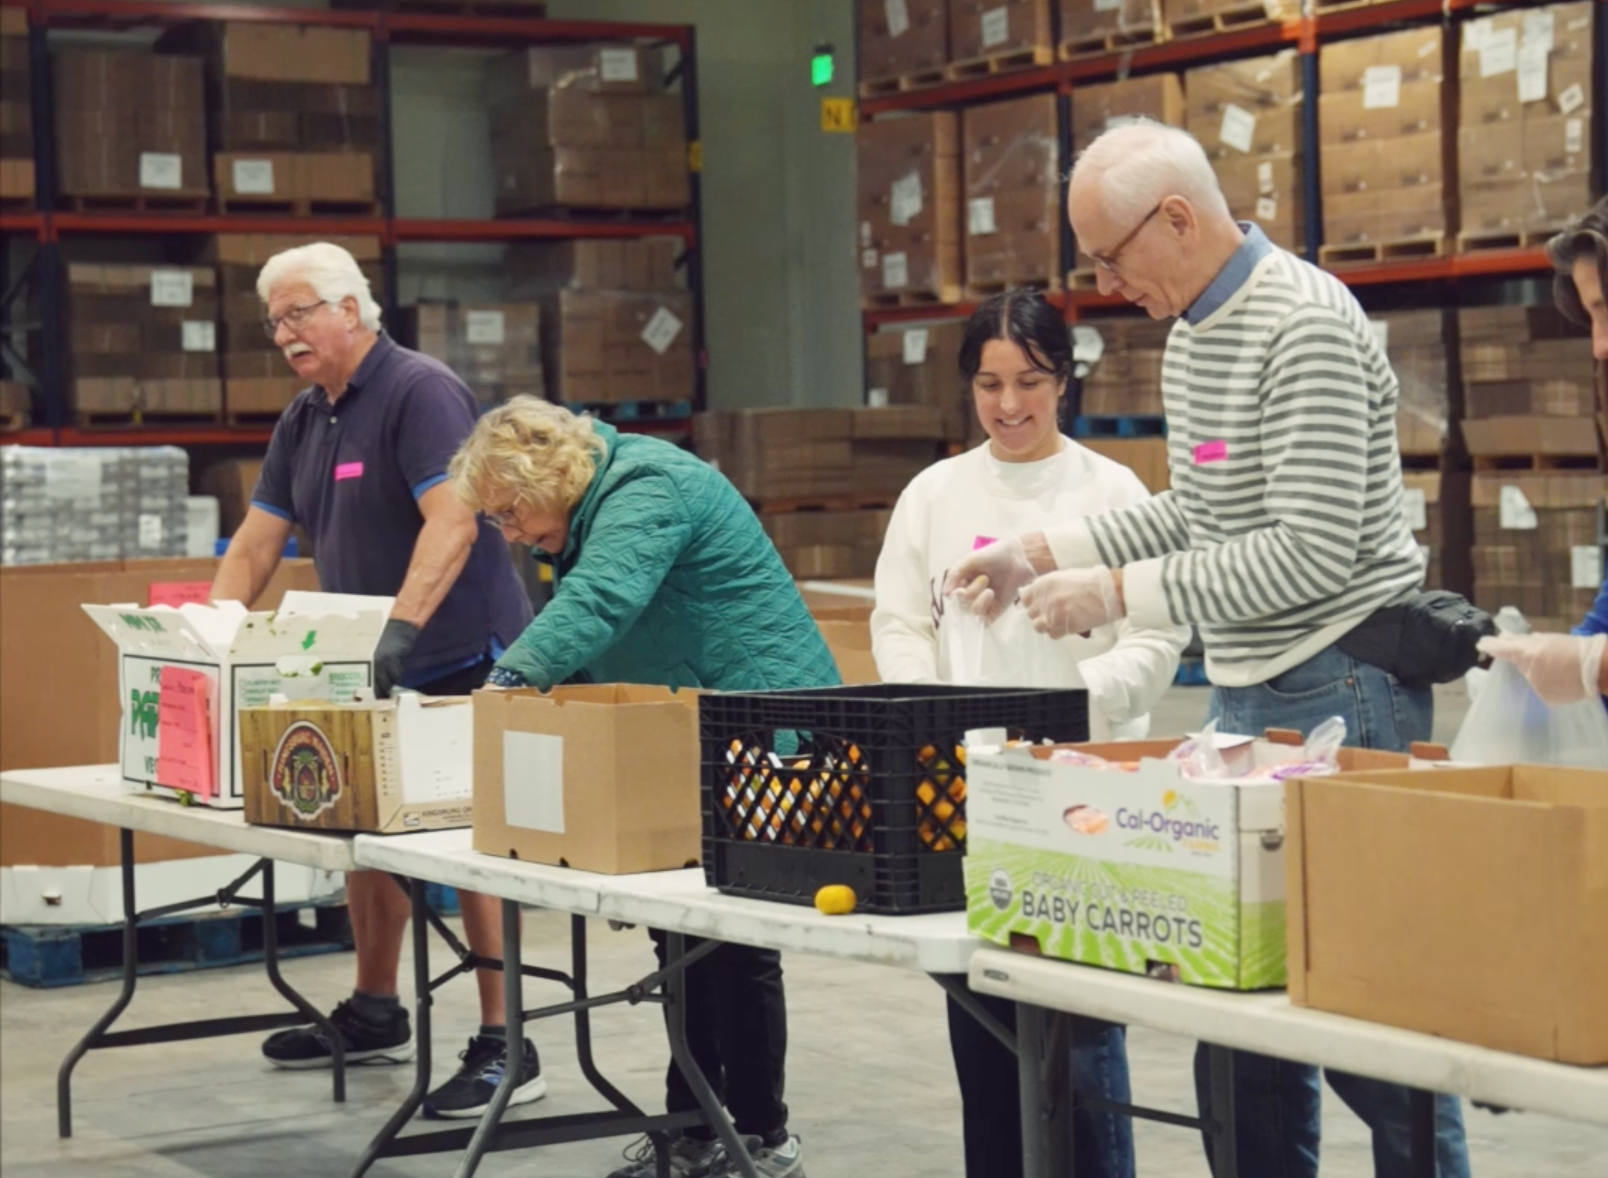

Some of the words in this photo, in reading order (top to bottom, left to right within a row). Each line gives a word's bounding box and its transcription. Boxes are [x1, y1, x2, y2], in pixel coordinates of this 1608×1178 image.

[1116, 807, 1219, 841] Cal-Organic
[1033, 871, 1086, 896] ORGANIC
[1091, 882, 1116, 900] CUT
[1133, 888, 1188, 912] PEELED
[1022, 890, 1079, 925] BABY
[1086, 904, 1202, 948] CARROTS
